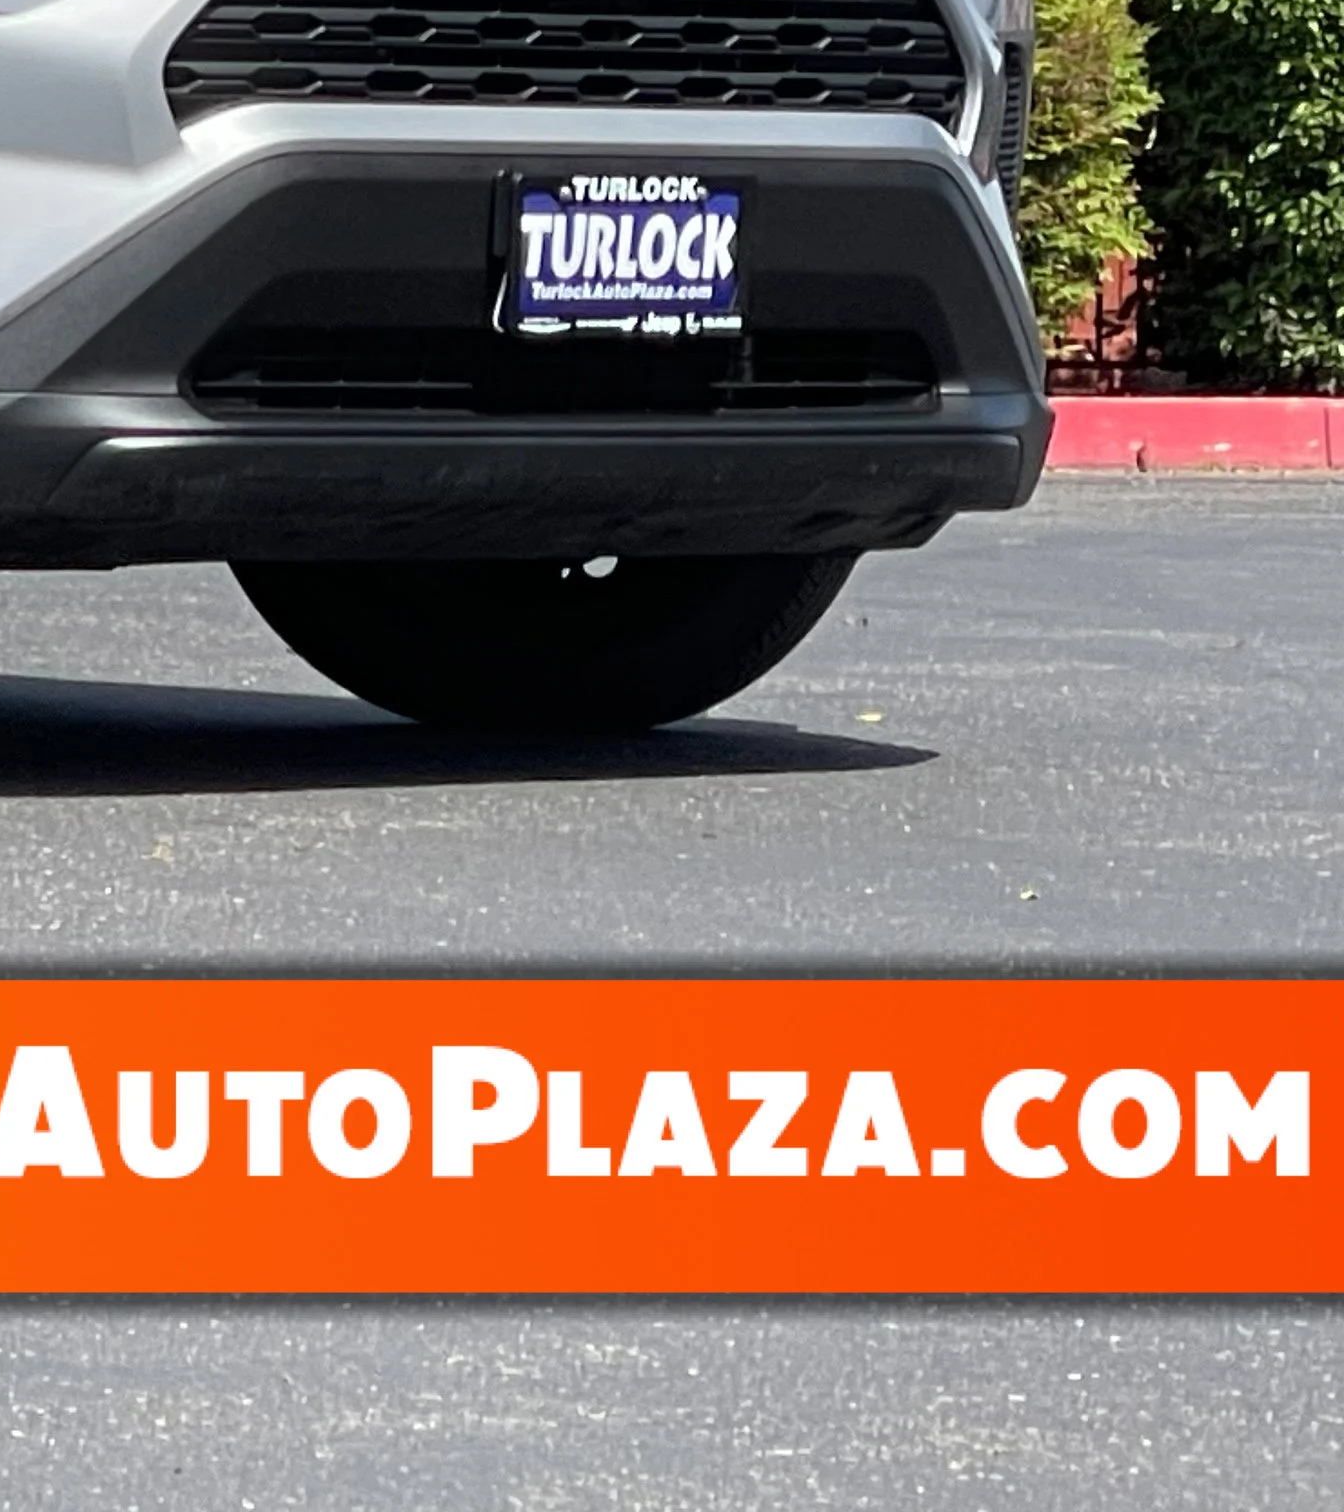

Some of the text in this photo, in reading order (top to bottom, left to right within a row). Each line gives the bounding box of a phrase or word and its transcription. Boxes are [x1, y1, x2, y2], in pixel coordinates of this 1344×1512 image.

[571, 175, 699, 202] TURLOCK
[520, 212, 737, 280] TURLOCK
[531, 281, 713, 301] TurlockAutoPlaza.com
